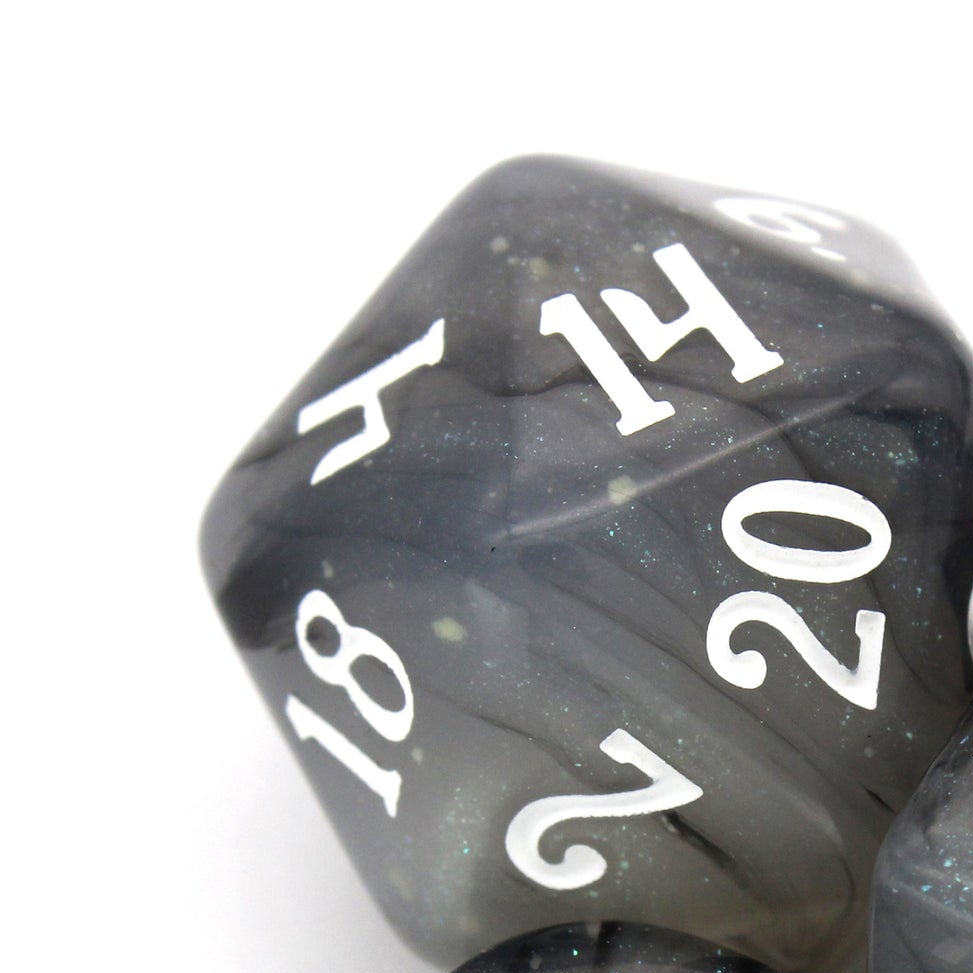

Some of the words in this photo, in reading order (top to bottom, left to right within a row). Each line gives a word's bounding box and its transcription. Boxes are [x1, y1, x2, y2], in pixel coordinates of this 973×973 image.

[297, 318, 445, 485] 4
[540, 243, 784, 436] 14
[706, 479, 892, 710] 20
[286, 589, 414, 817] 18
[506, 729, 703, 890] 2
